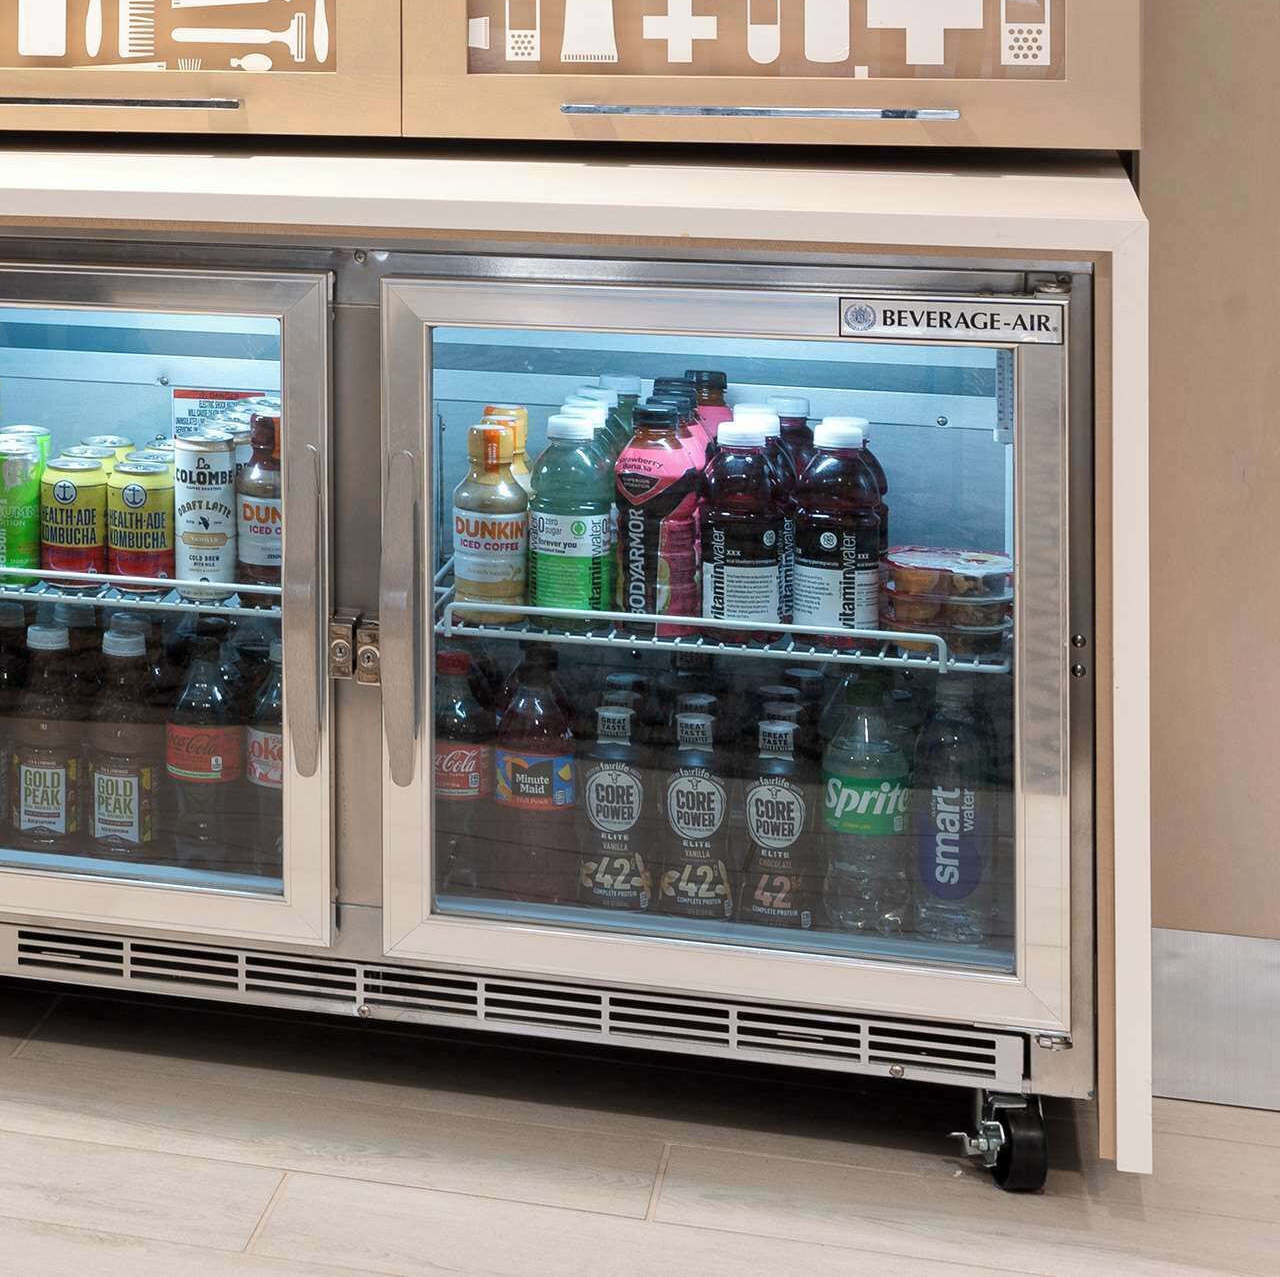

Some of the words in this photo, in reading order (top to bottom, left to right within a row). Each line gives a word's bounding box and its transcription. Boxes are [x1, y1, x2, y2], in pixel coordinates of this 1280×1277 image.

[882, 309, 1052, 332] BEVERAGE-AIR
[175, 469, 234, 486] COLOMBE
[177, 499, 203, 518] DRAFT
[205, 499, 233, 520] LATTE
[248, 524, 273, 536] ICED
[460, 537, 481, 550] ICED
[484, 540, 519, 552] COFFEE
[562, 540, 578, 550] you
[601, 717, 627, 725] GREAT
[600, 762, 630, 773] fairlife
[515, 773, 550, 786] Minute
[24, 786, 62, 806] PEAK
[519, 783, 545, 795] Maid
[595, 783, 635, 804] CORE
[825, 777, 910, 818] Sprite
[676, 789, 716, 811] CORE
[595, 804, 635, 821] POWER
[962, 788, 976, 832] water
[676, 810, 716, 828] POWER
[601, 833, 630, 841] ELITE
[932, 785, 961, 885] smart
